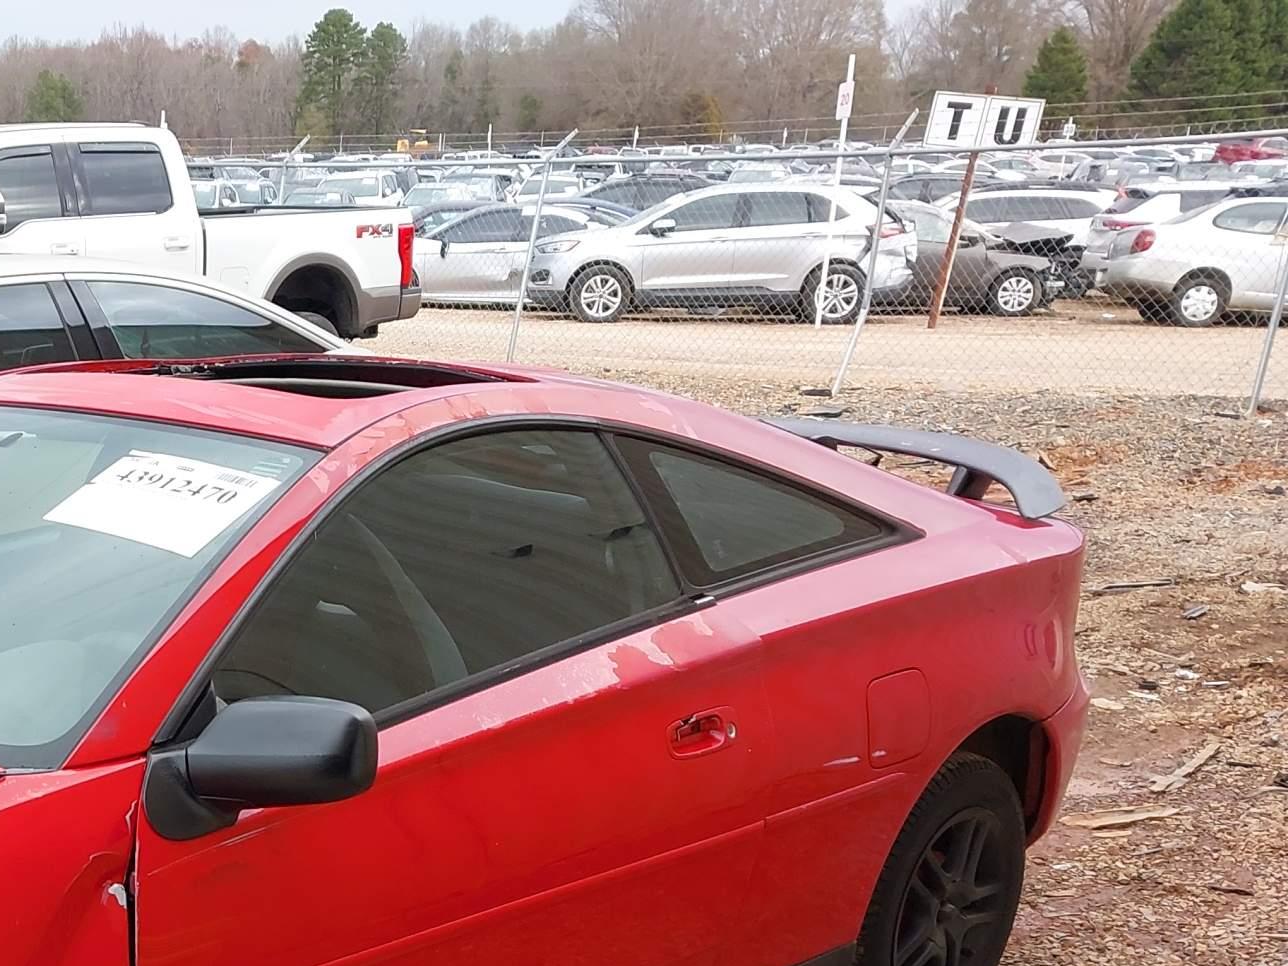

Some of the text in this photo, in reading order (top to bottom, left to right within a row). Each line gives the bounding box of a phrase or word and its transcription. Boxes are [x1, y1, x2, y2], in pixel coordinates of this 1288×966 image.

[947, 101, 1028, 145] T U
[356, 223, 393, 238] FX4
[116, 468, 238, 504] 43912470
